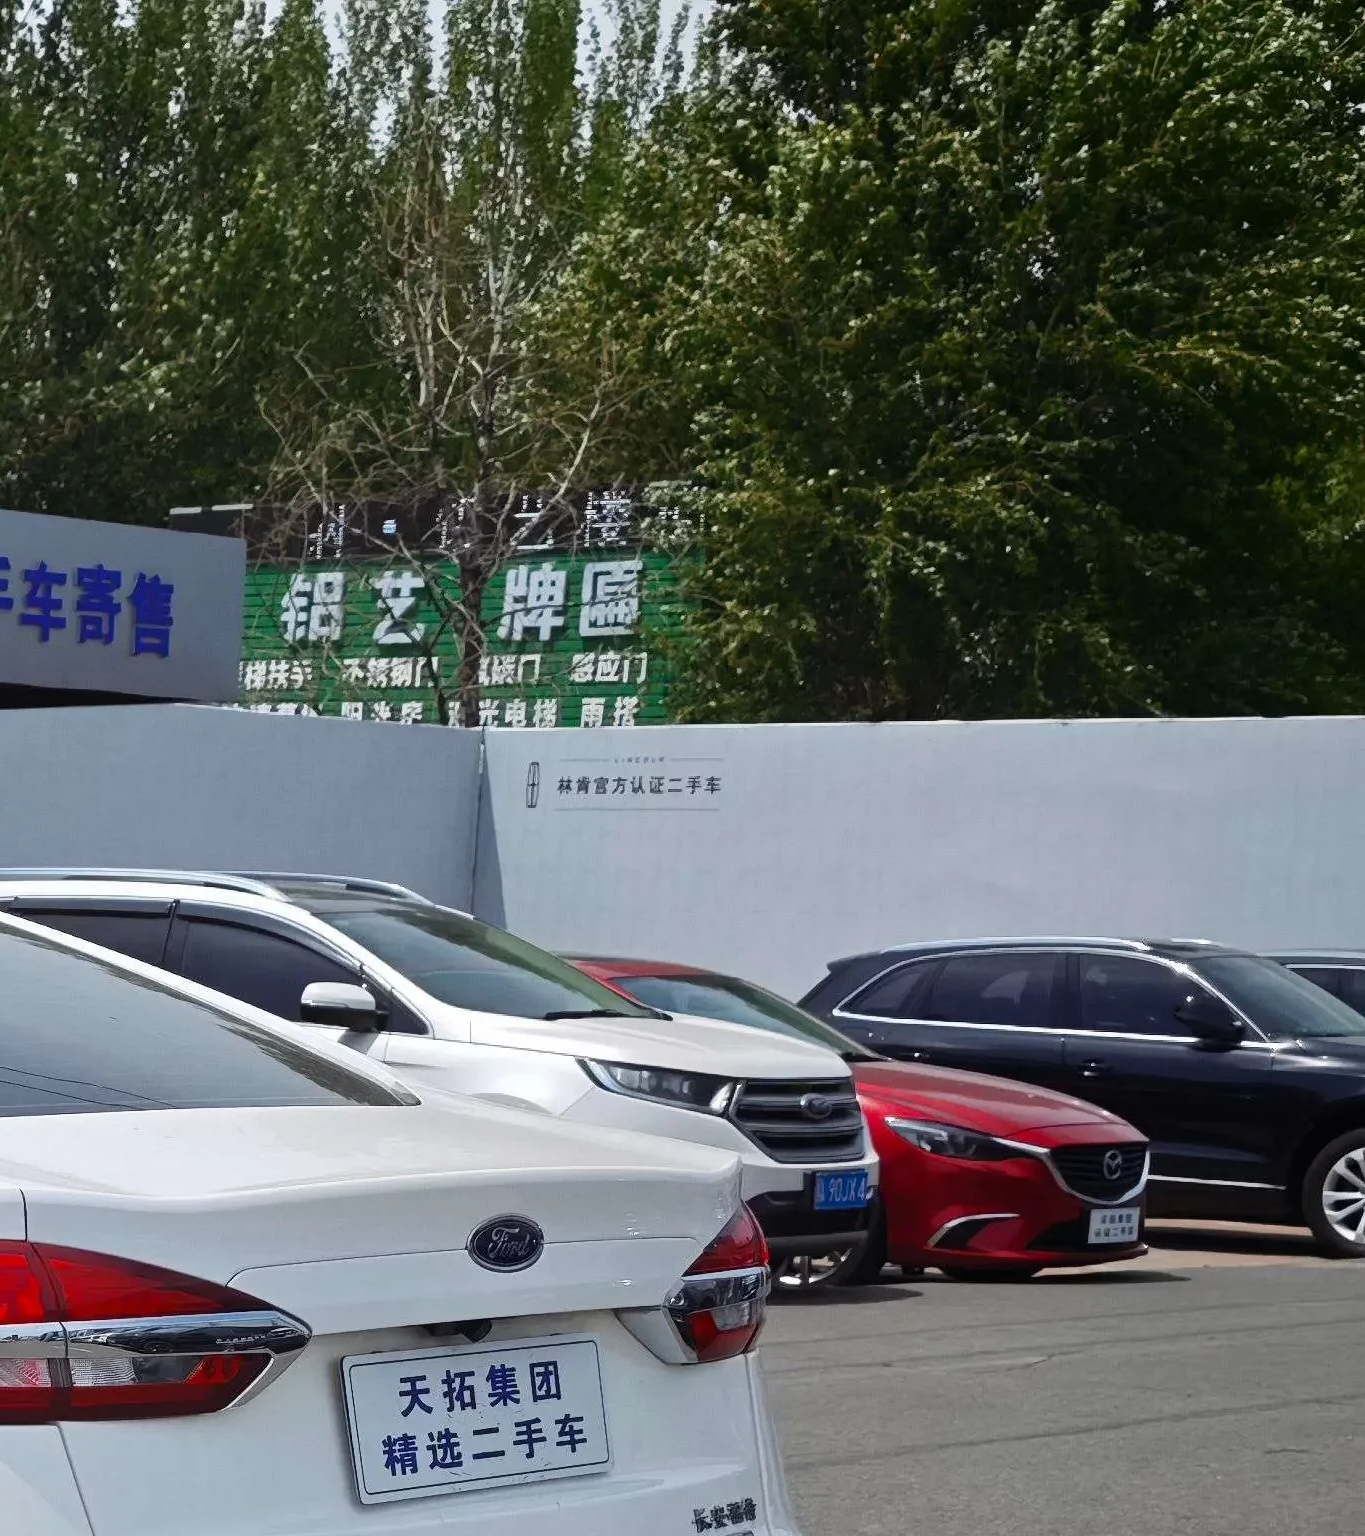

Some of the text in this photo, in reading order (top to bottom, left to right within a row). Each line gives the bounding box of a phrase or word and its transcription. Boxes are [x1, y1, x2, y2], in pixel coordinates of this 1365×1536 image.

[280, 570, 425, 645] 铝艺
[238, 658, 313, 690] 梯扶手
[556, 775, 722, 795] 林肯官方认证二手车
[397, 1360, 564, 1418] 天拓集团
[381, 1413, 589, 1478] 精选二手车
